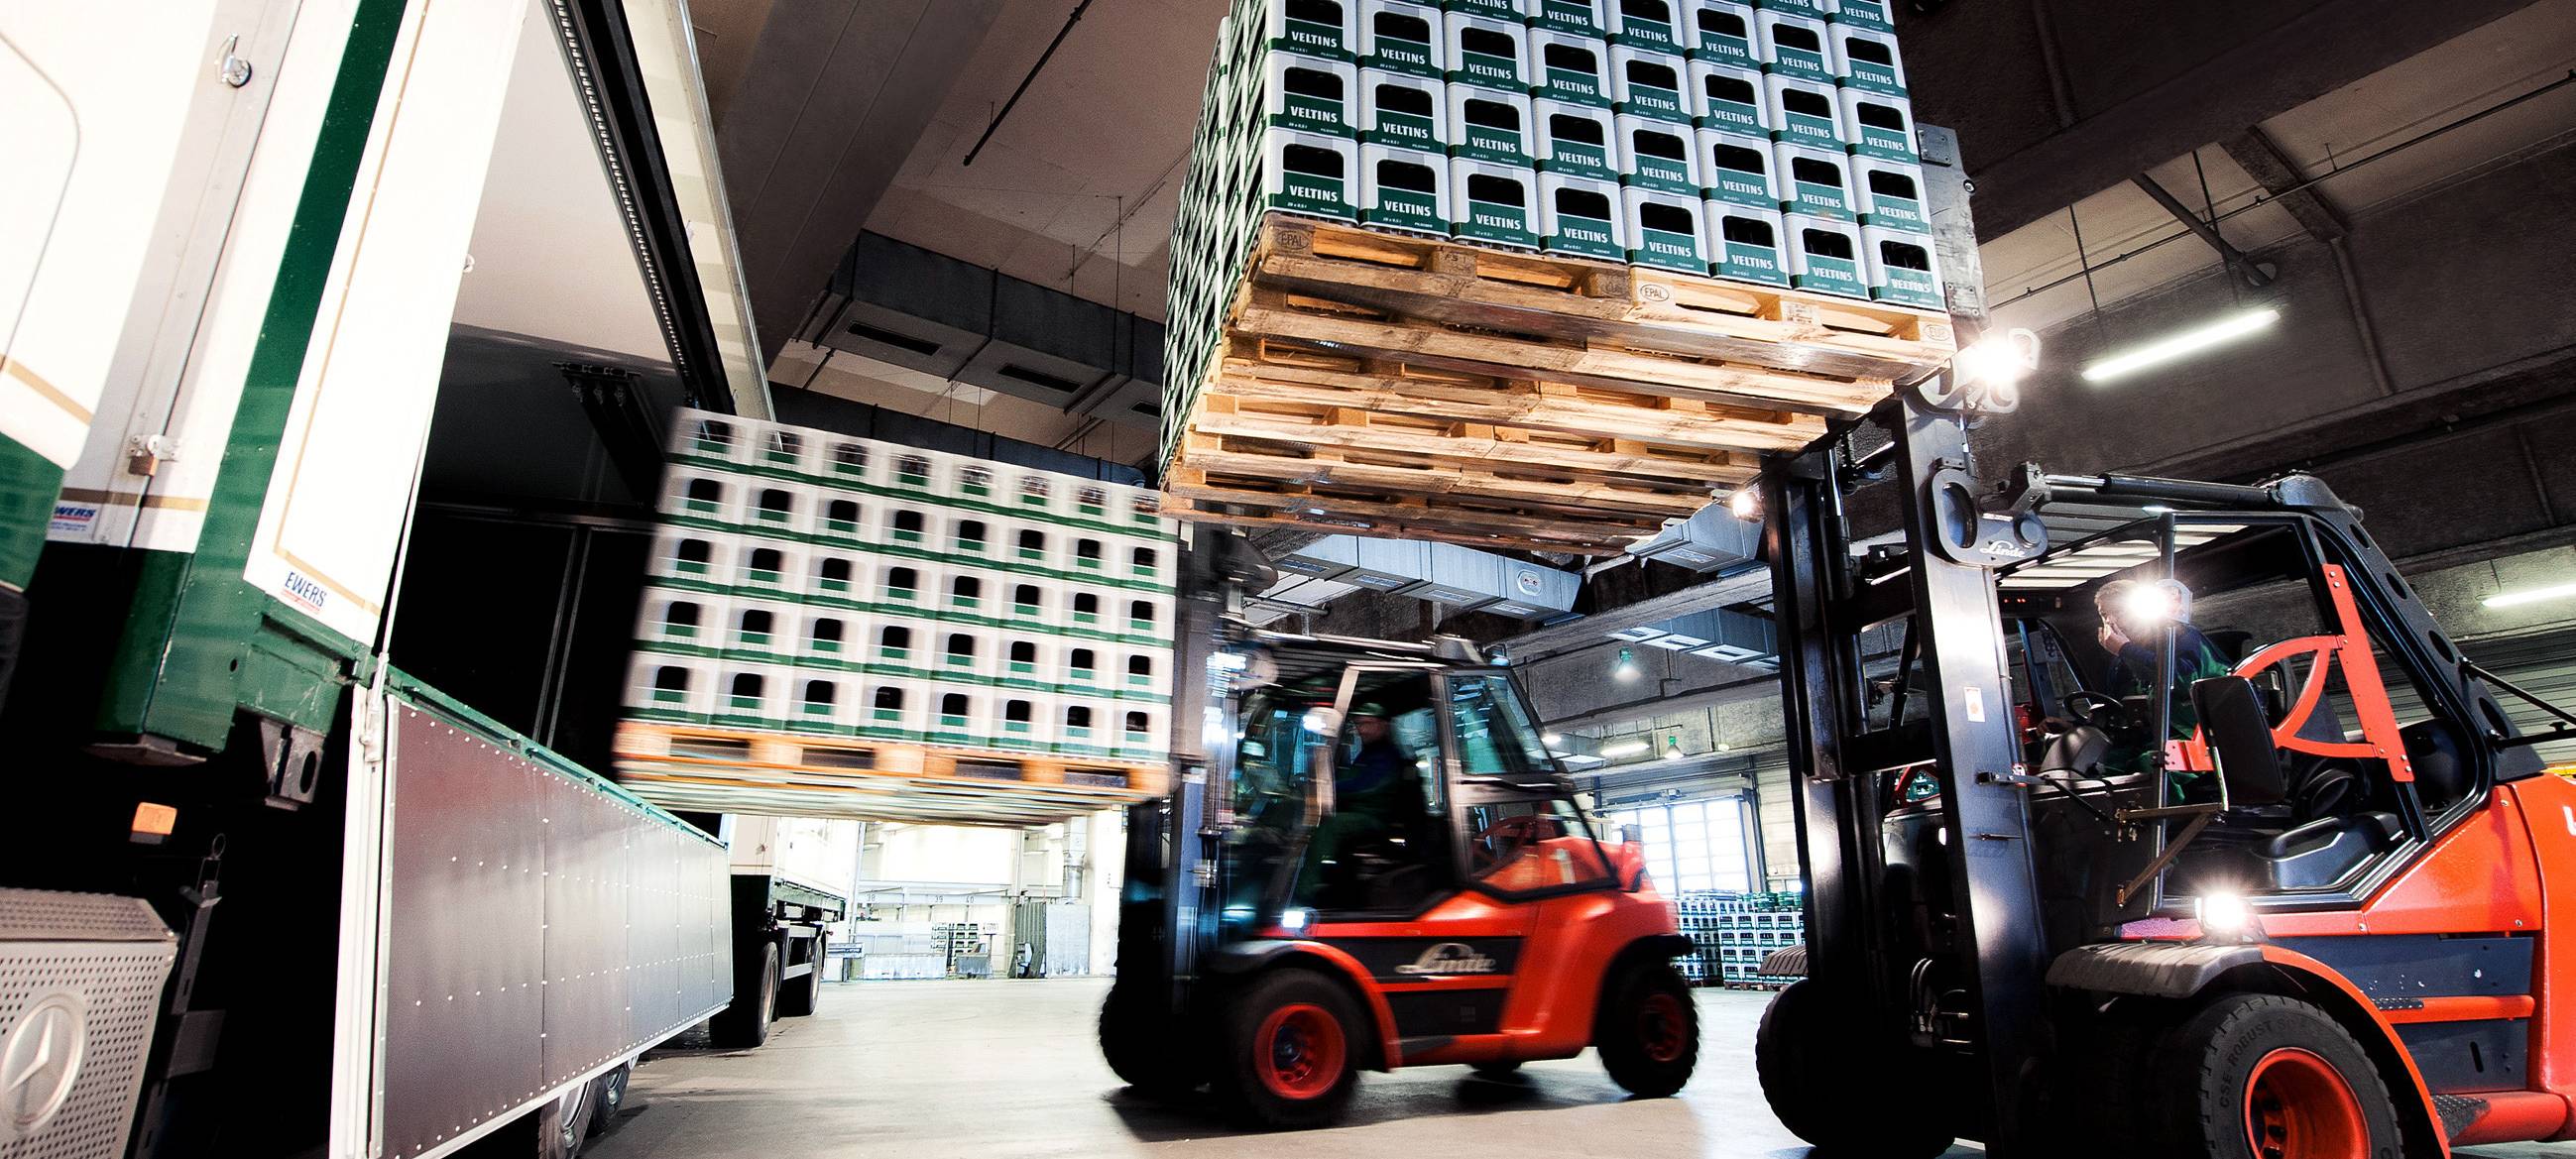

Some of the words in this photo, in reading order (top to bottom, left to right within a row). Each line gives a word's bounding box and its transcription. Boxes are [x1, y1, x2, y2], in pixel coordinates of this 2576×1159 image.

[1547, 10, 1588, 26] VELTINS
[1843, 6, 1880, 22] VELTINS
[1292, 31, 1338, 48] VELTINS
[1628, 27, 1668, 43] VELTINS
[1381, 48, 1426, 64] VELTINS
[1705, 42, 1745, 58] VELTINS
[1468, 63, 1512, 79] VELTINS
[1781, 57, 1819, 72] VELTINS
[1855, 69, 1893, 85] VELTINS
[1552, 78, 1594, 95] VELTINS
[1634, 95, 1676, 111] VELTINS
[1290, 106, 1338, 123] VELTINS
[1713, 109, 1754, 125] VELTINS
[1382, 122, 1429, 139] VELTINS
[1792, 123, 1830, 138] VELTINS
[1471, 137, 1517, 153] VELTINS
[1866, 136, 1905, 152] VELTINS
[1558, 151, 1601, 168] VELTINS
[1641, 166, 1684, 182] VELTINS
[1289, 184, 1338, 202] VELTINS
[1722, 180, 1764, 195] VELTINS
[1384, 200, 1431, 217] VELTINS
[1802, 193, 1841, 208] VELTINS
[1475, 213, 1521, 230] VELTINS
[1878, 206, 1918, 221] VELTINS
[1564, 227, 1608, 244] VELTINS
[1649, 241, 1692, 258] VELTINS
[1731, 254, 1774, 270] VELTINS
[1813, 266, 1853, 282] VELTINS
[1644, 287, 1665, 298] EPAL
[1980, 540, 2025, 557] Linde
[285, 571, 327, 607] EWERS
